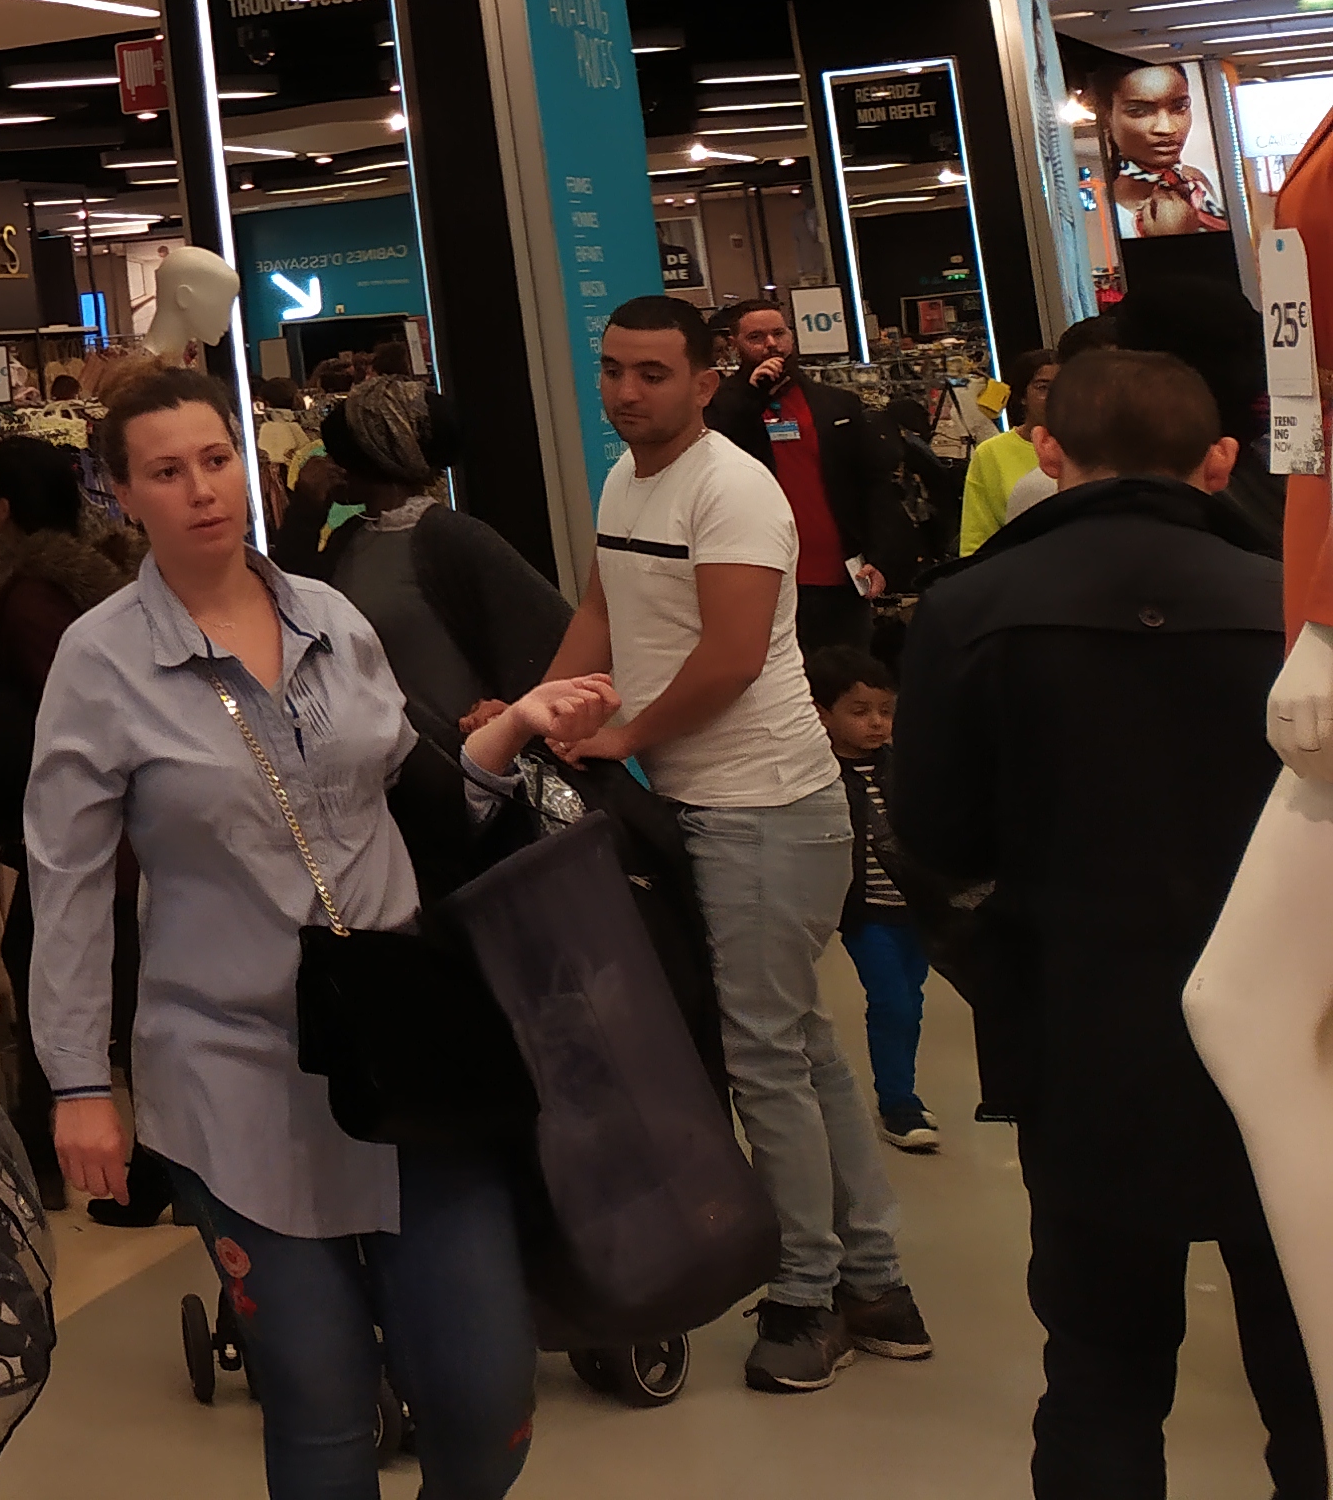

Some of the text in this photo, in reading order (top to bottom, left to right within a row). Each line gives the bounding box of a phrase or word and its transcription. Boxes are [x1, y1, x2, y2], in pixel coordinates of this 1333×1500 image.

[856, 101, 937, 124] MON REFLET
[1255, 132, 1308, 149] CAISS
[666, 253, 689, 266] DE
[801, 311, 843, 333] 10€
[1270, 301, 1308, 348] 25€
[1273, 416, 1298, 427] TREND
[1273, 428, 1290, 440] ING
